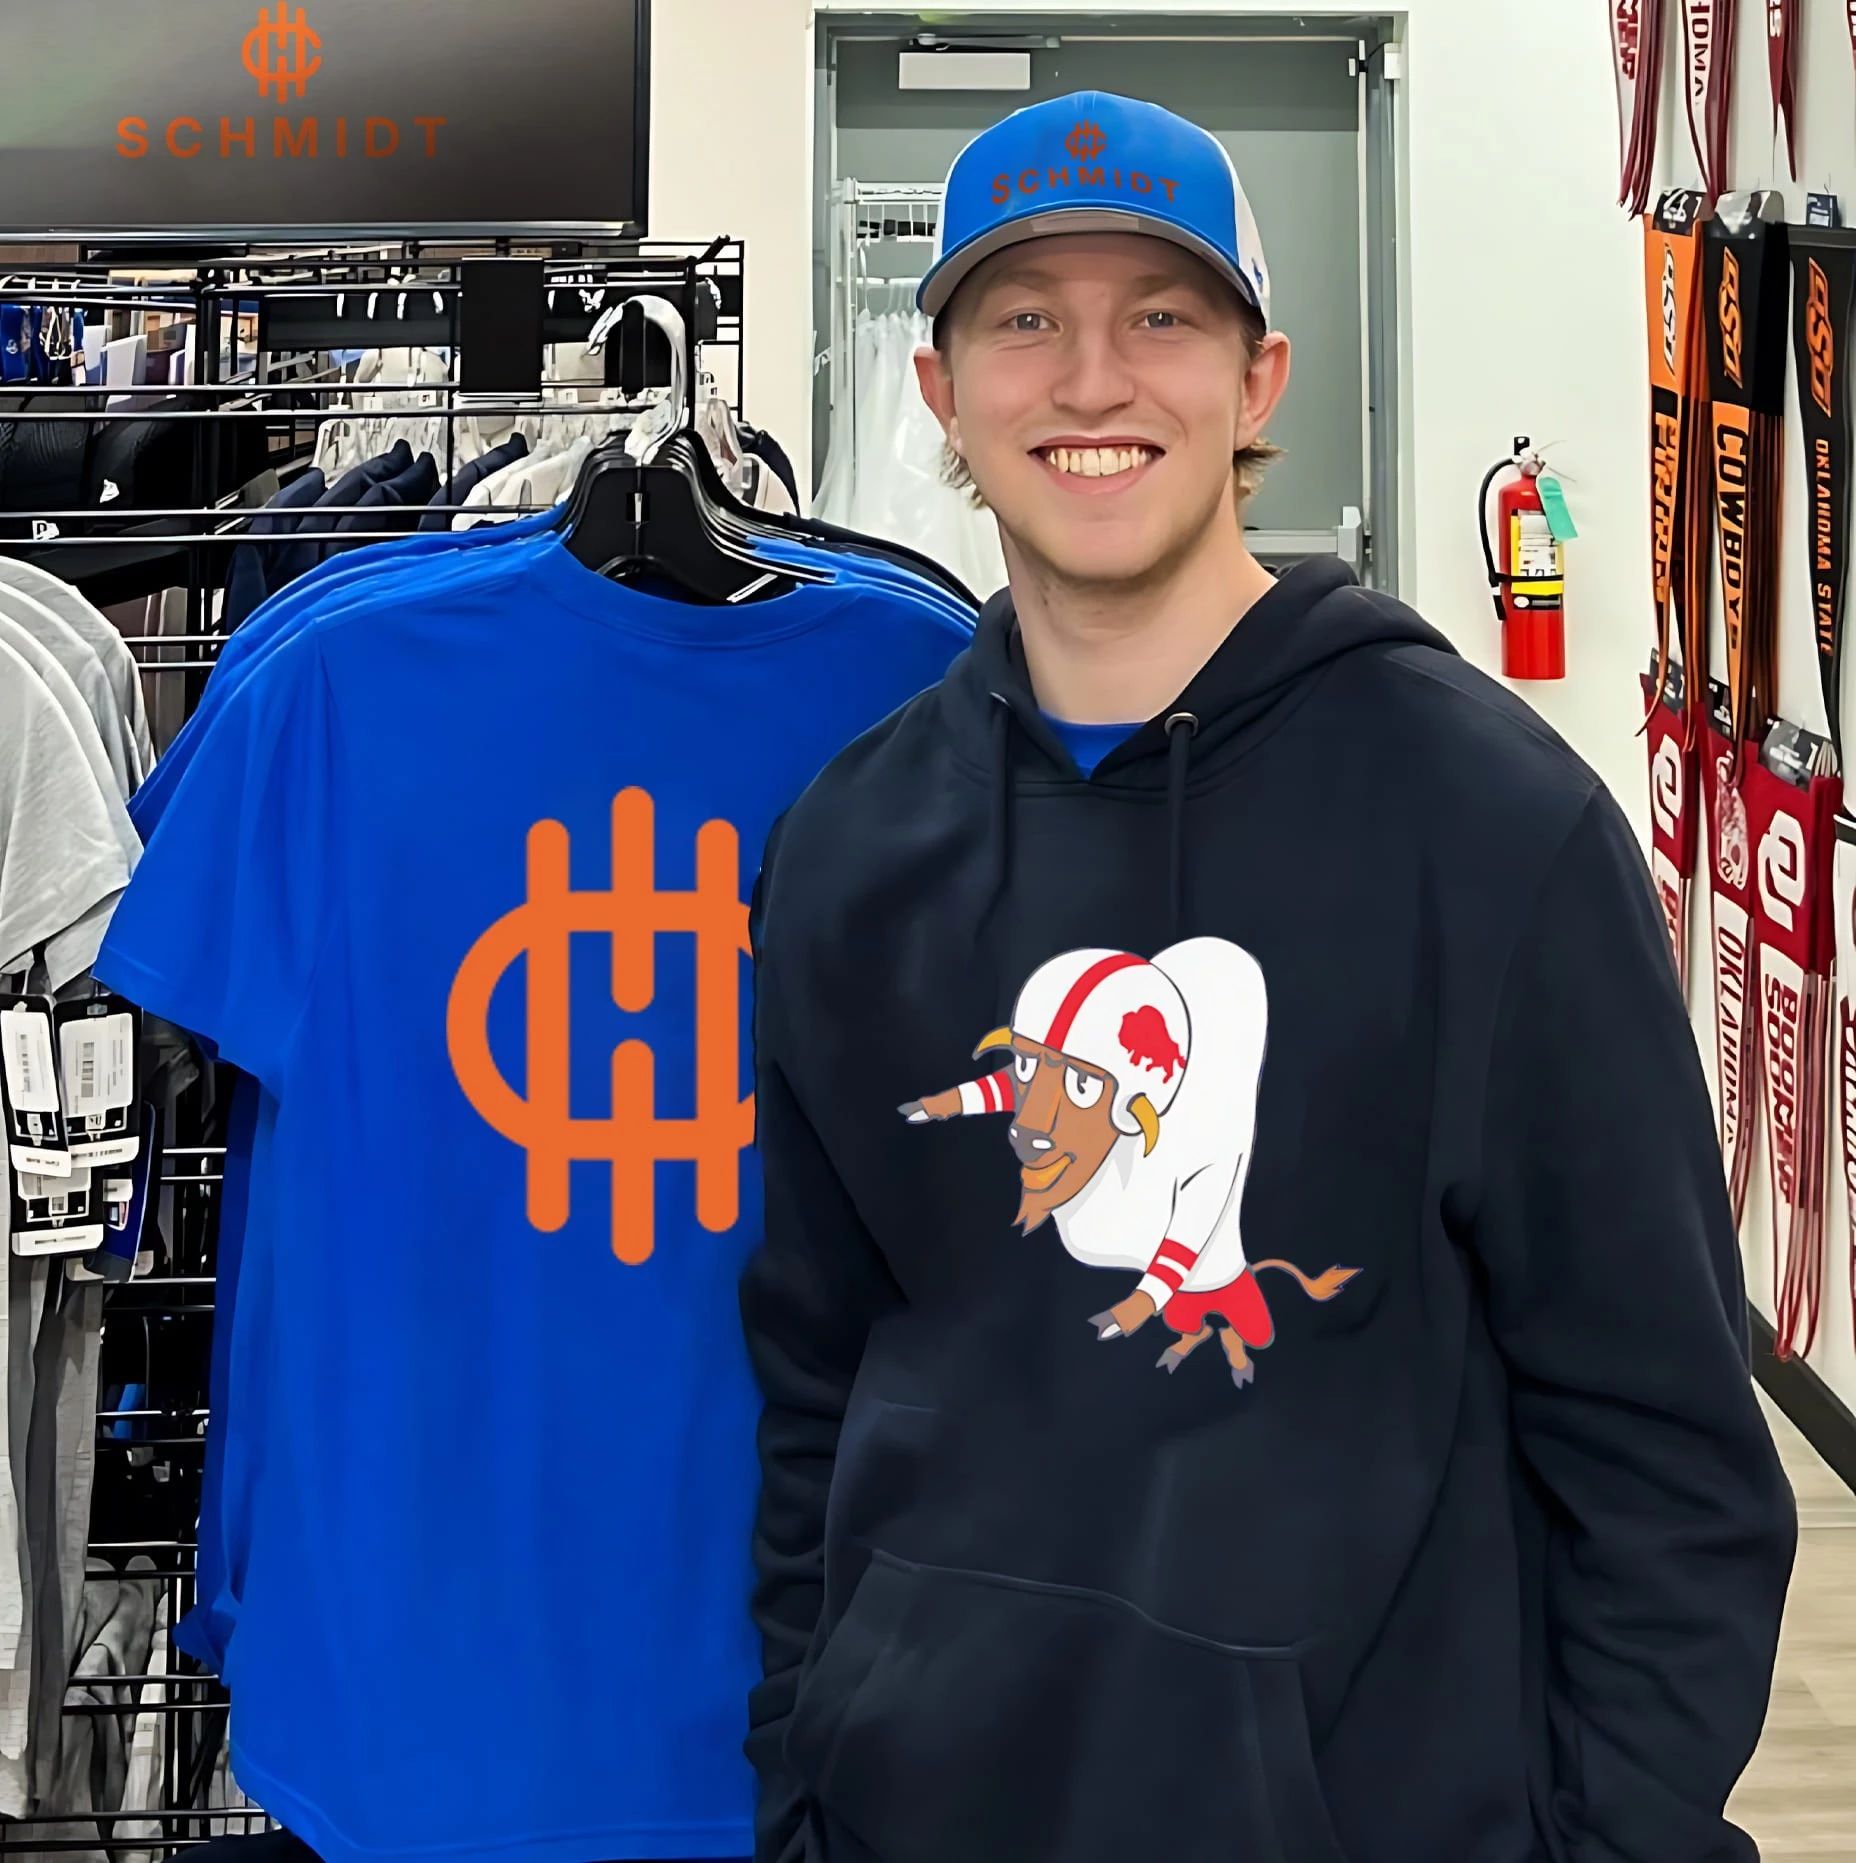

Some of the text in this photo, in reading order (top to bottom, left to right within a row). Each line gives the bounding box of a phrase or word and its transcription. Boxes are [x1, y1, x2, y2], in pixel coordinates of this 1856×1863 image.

[116, 116, 447, 159] SCHMIDT
[991, 166, 1181, 205] SCHMIDT
[1816, 438, 1832, 570] OKLAHOMA
[1719, 925, 1745, 1144] OKLAHOMA
